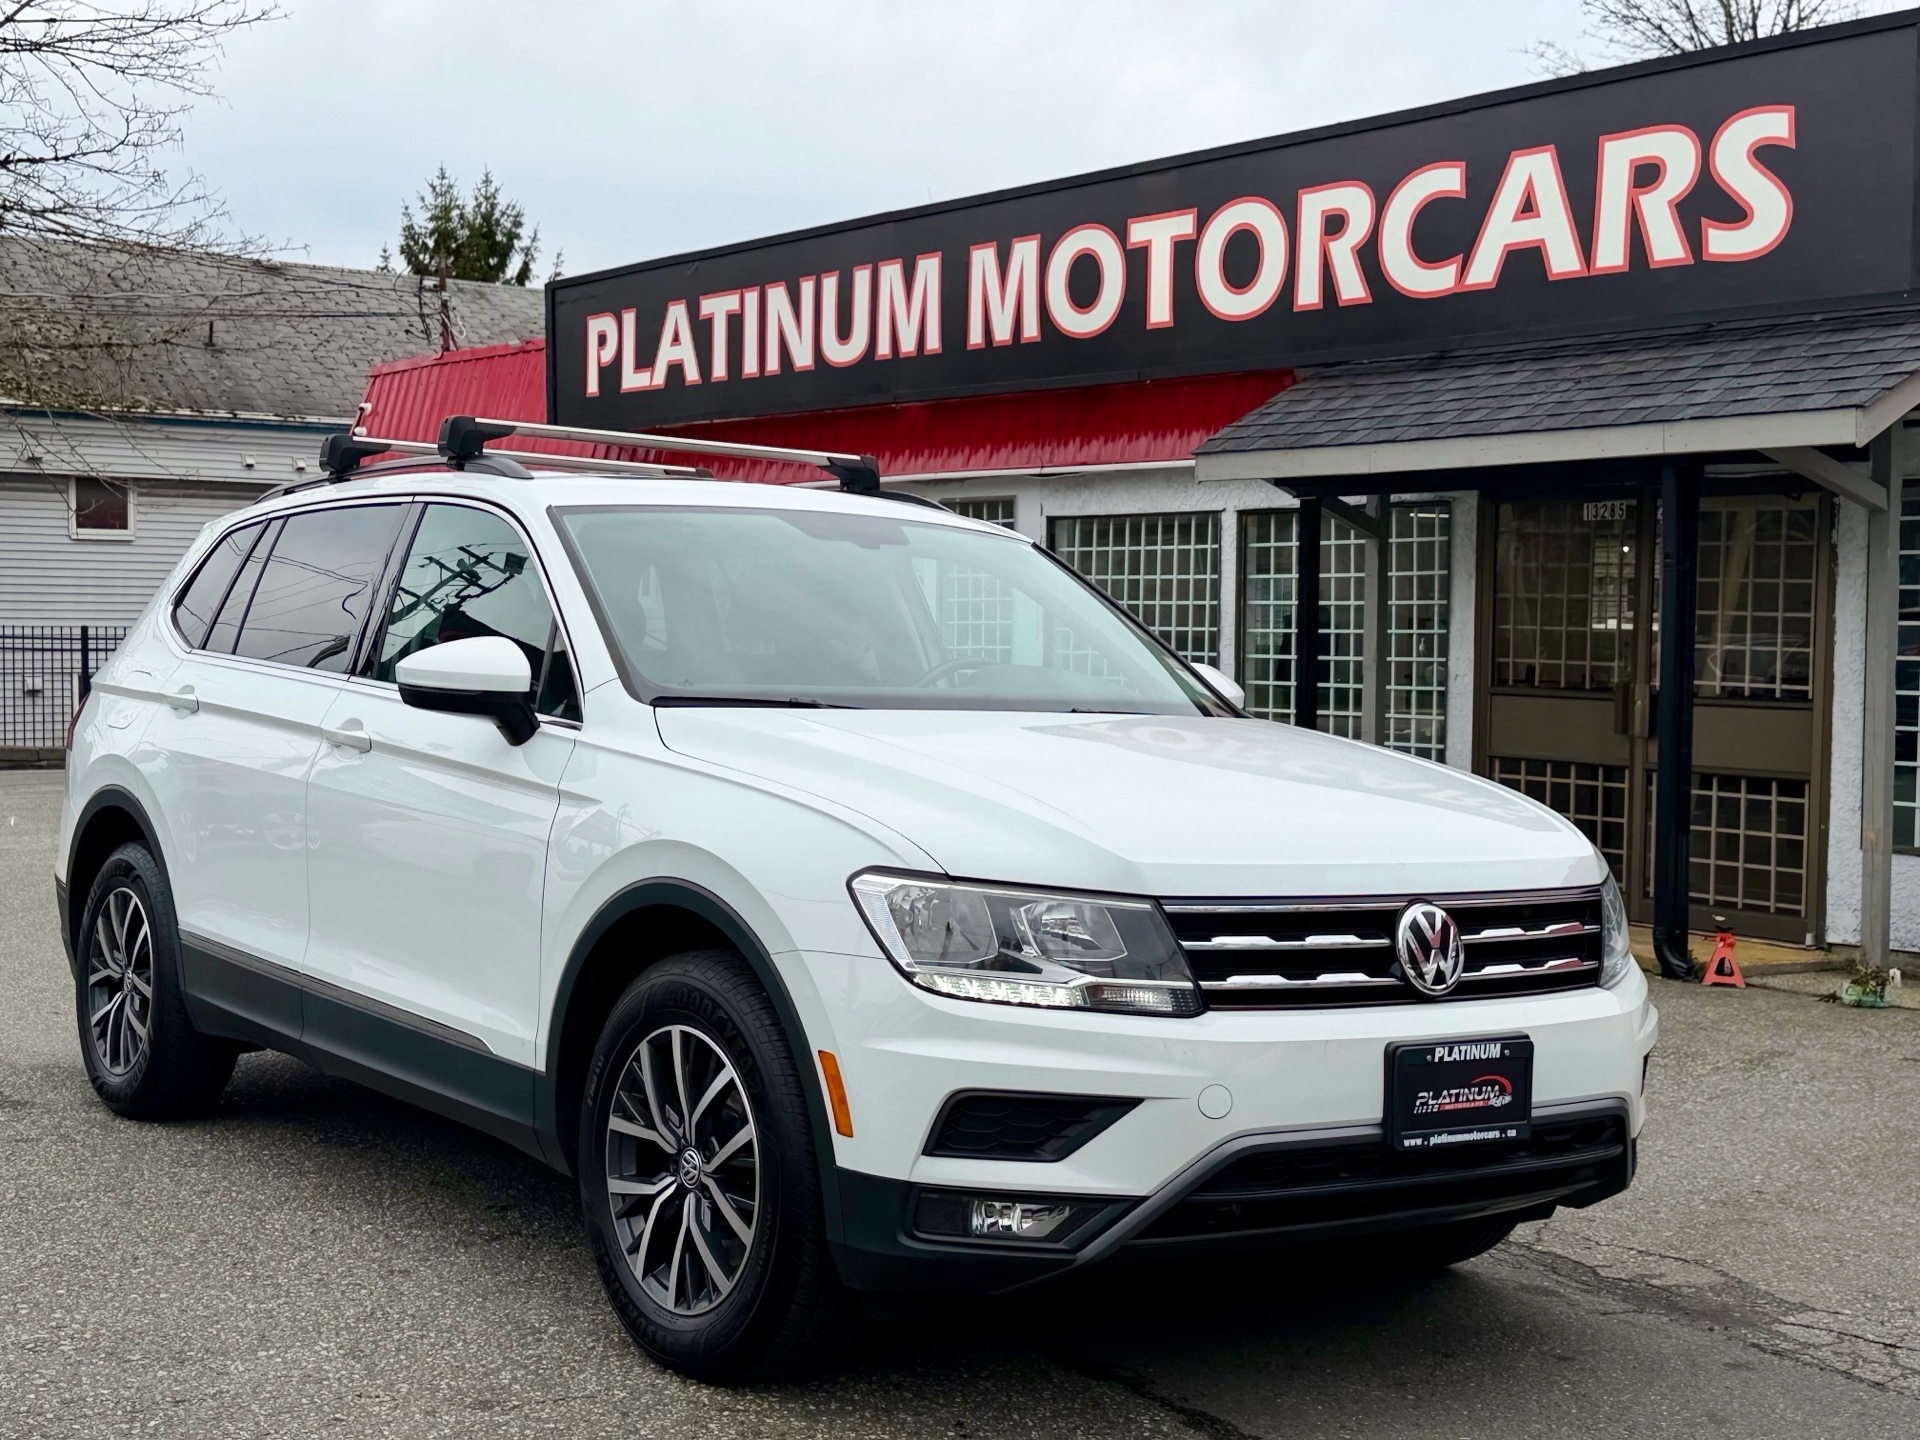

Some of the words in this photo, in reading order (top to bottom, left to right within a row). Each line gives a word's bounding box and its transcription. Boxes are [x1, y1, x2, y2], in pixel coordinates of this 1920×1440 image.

[585, 251, 942, 397] PLATINUM
[966, 104, 1796, 352] MOTORCARS
[1585, 502, 1625, 520] 13285
[1434, 1043, 1501, 1063] PLATINUM
[1415, 1085, 1499, 1107] PLATINUM
